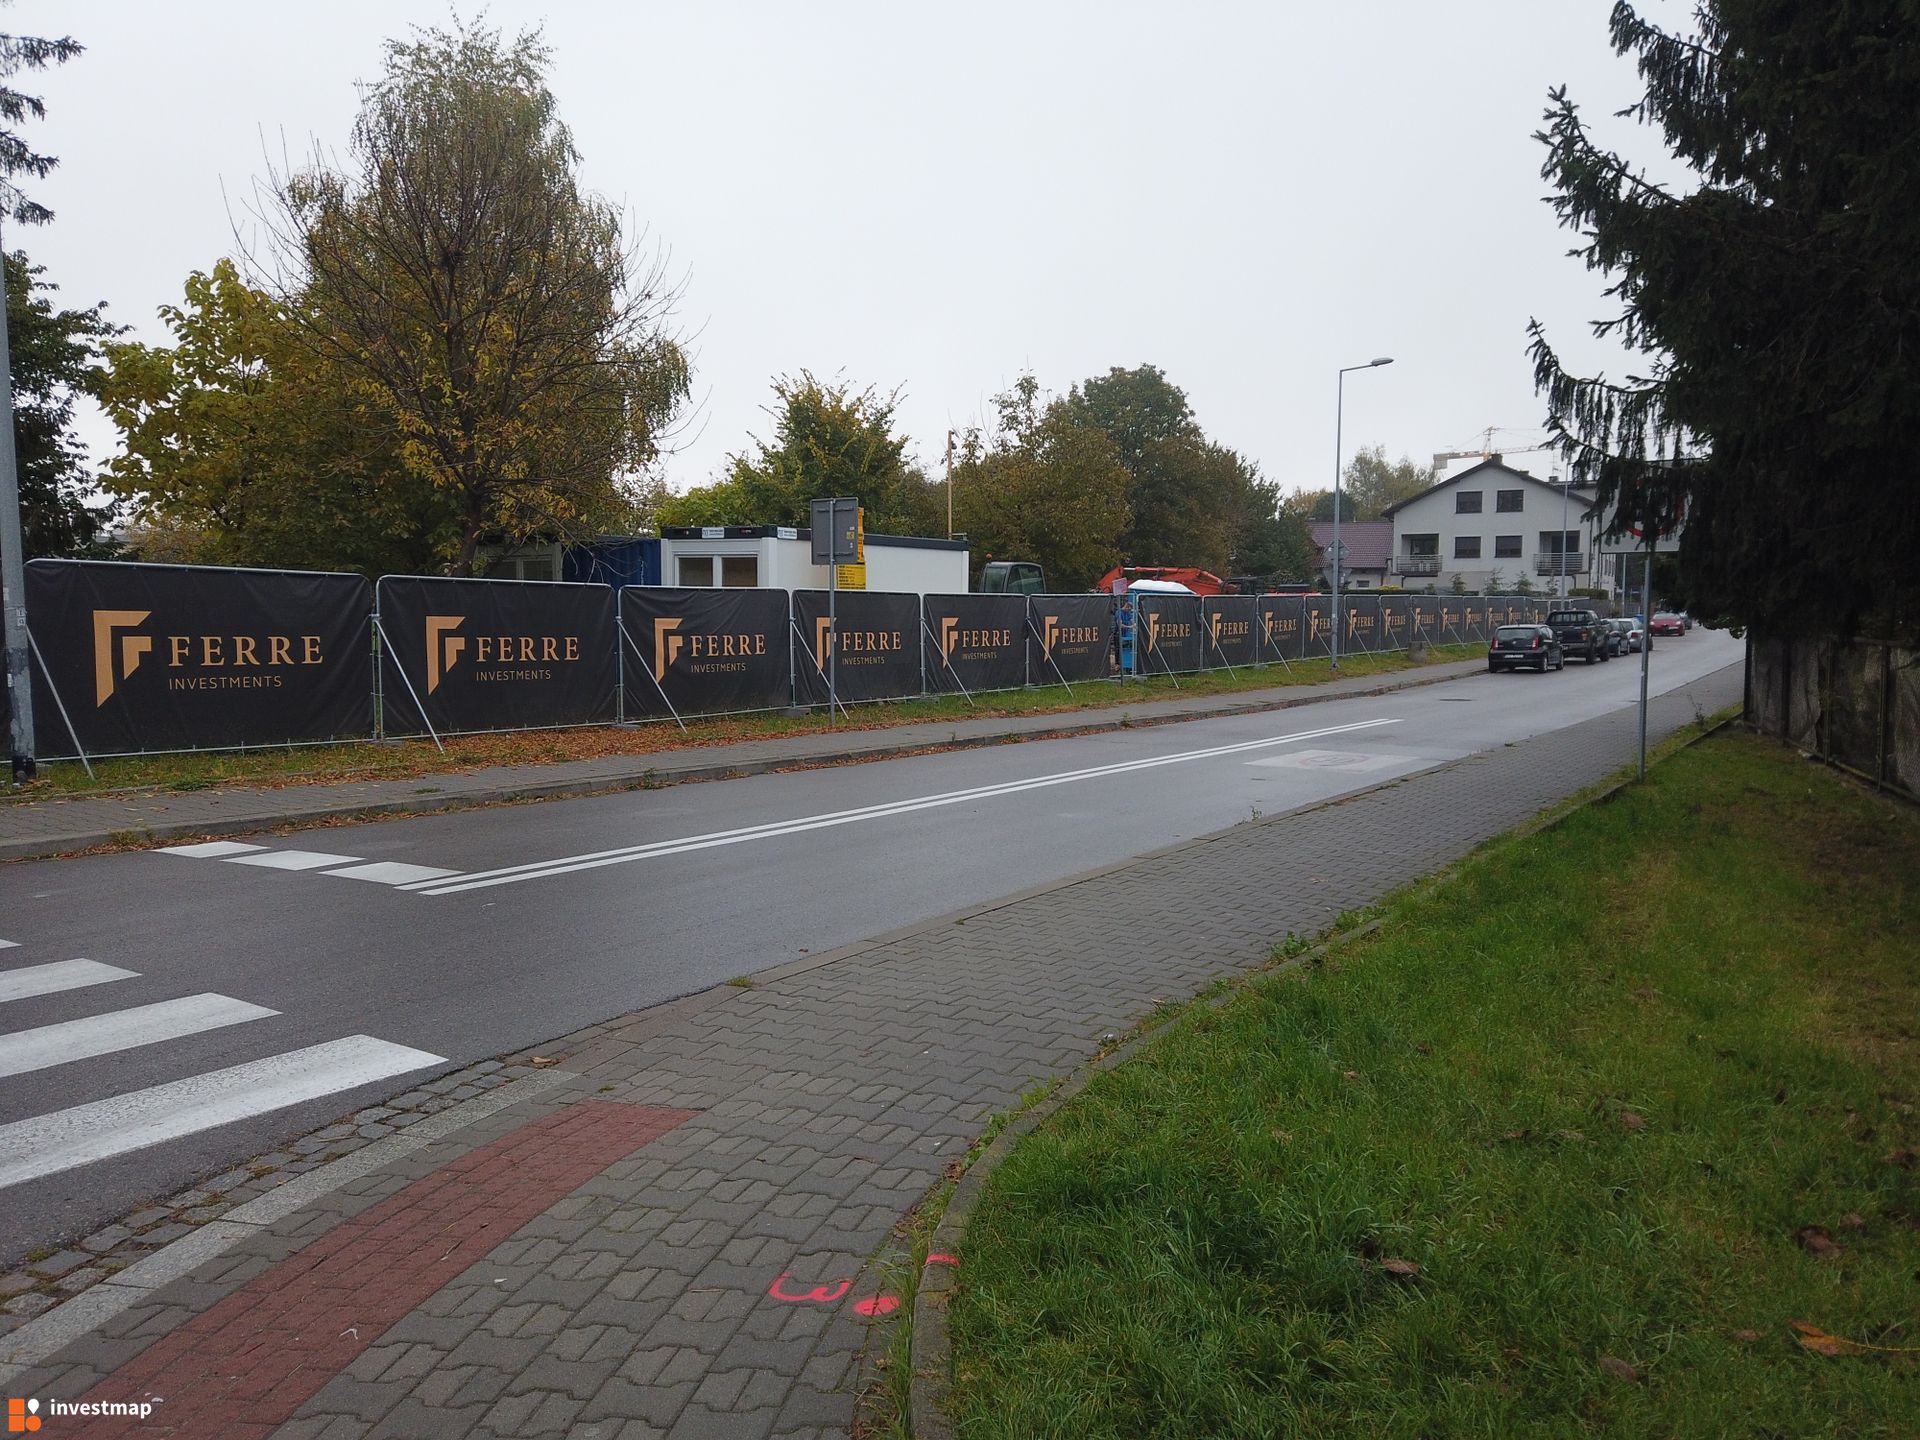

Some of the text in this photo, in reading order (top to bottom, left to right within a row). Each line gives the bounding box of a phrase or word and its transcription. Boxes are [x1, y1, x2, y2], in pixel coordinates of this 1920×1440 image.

[1161, 623, 1191, 638] FERRE
[1223, 622, 1249, 636] FERRE
[1274, 619, 1297, 633] FERRE
[841, 631, 902, 651] FERRE
[962, 630, 1011, 648] FERRE
[1062, 626, 1099, 643] FERRE
[167, 635, 324, 667] FERRE
[476, 636, 580, 663] FERRE
[690, 634, 766, 657] FERRE
[690, 662, 747, 673] INVESTMENTS
[842, 656, 885, 665] INVESTMENTS
[168, 675, 283, 691] INVESTMENTS
[475, 669, 552, 681] INVESTMENTS
